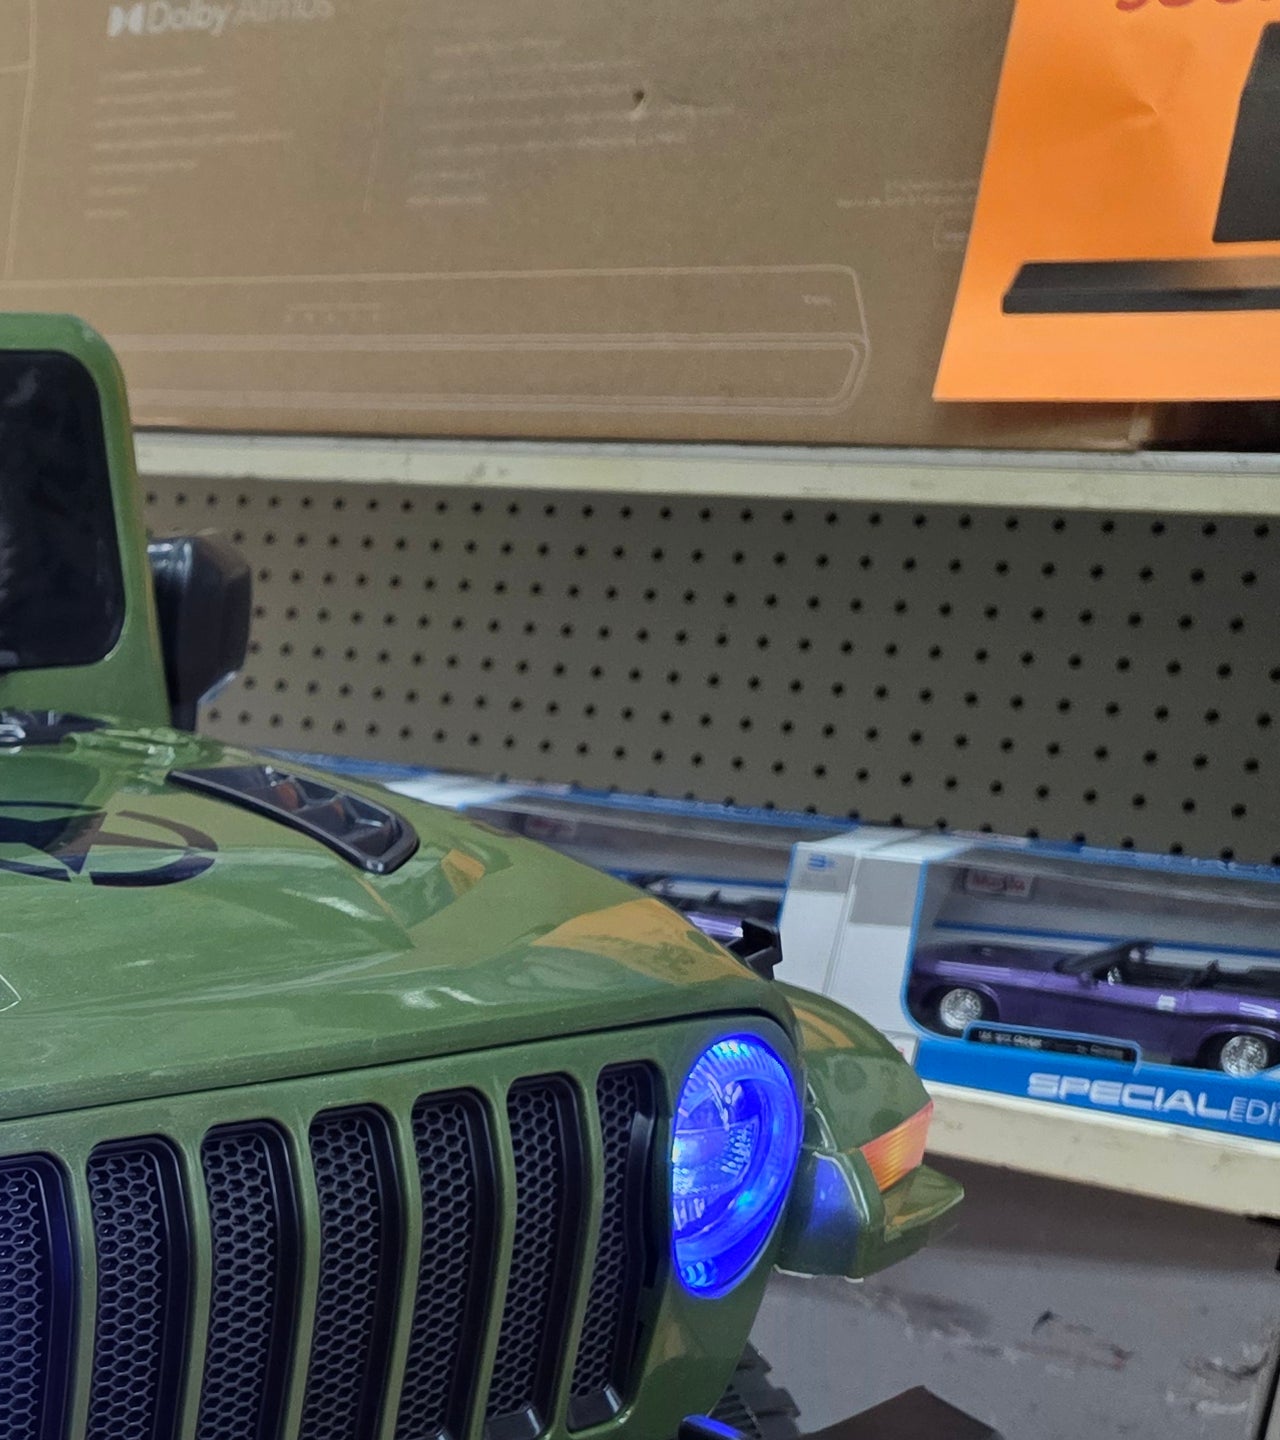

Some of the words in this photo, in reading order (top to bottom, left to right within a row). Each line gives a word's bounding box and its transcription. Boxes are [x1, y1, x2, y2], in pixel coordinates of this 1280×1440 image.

[146, 0, 223, 38] Dolby
[1027, 1072, 1229, 1120] SPECIAL
[1228, 1096, 1280, 1128] EDI
